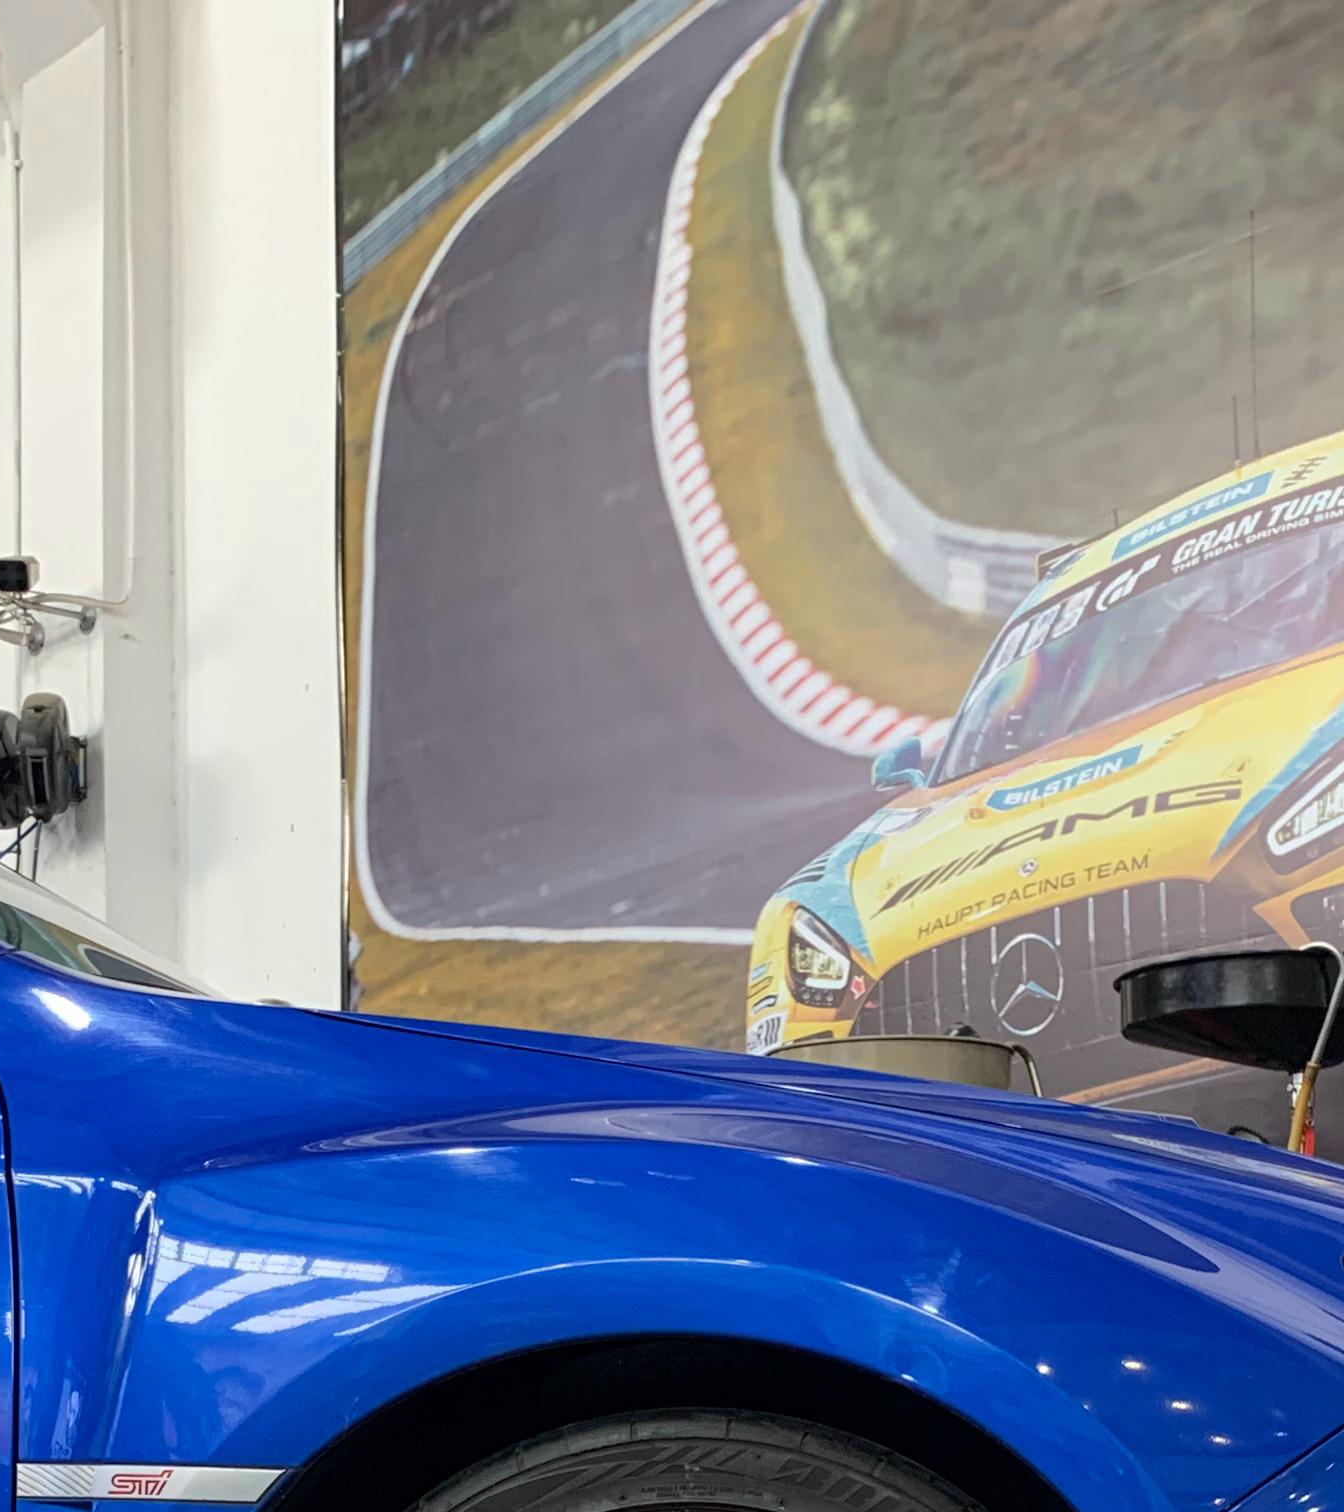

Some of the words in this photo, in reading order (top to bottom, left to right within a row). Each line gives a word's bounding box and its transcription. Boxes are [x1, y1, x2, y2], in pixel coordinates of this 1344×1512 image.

[1129, 483, 1256, 546] BILSTEIN
[1171, 508, 1263, 566] GRAN
[1171, 558, 1199, 574] THE
[1203, 543, 1242, 563] REAL
[1245, 517, 1311, 544] DRIVING
[1003, 757, 1123, 806] BILSTEIN
[972, 779, 1242, 869] AMG
[917, 902, 983, 941] HAUPT
[990, 873, 1076, 908] RACING
[1082, 852, 1150, 884] TEAM
